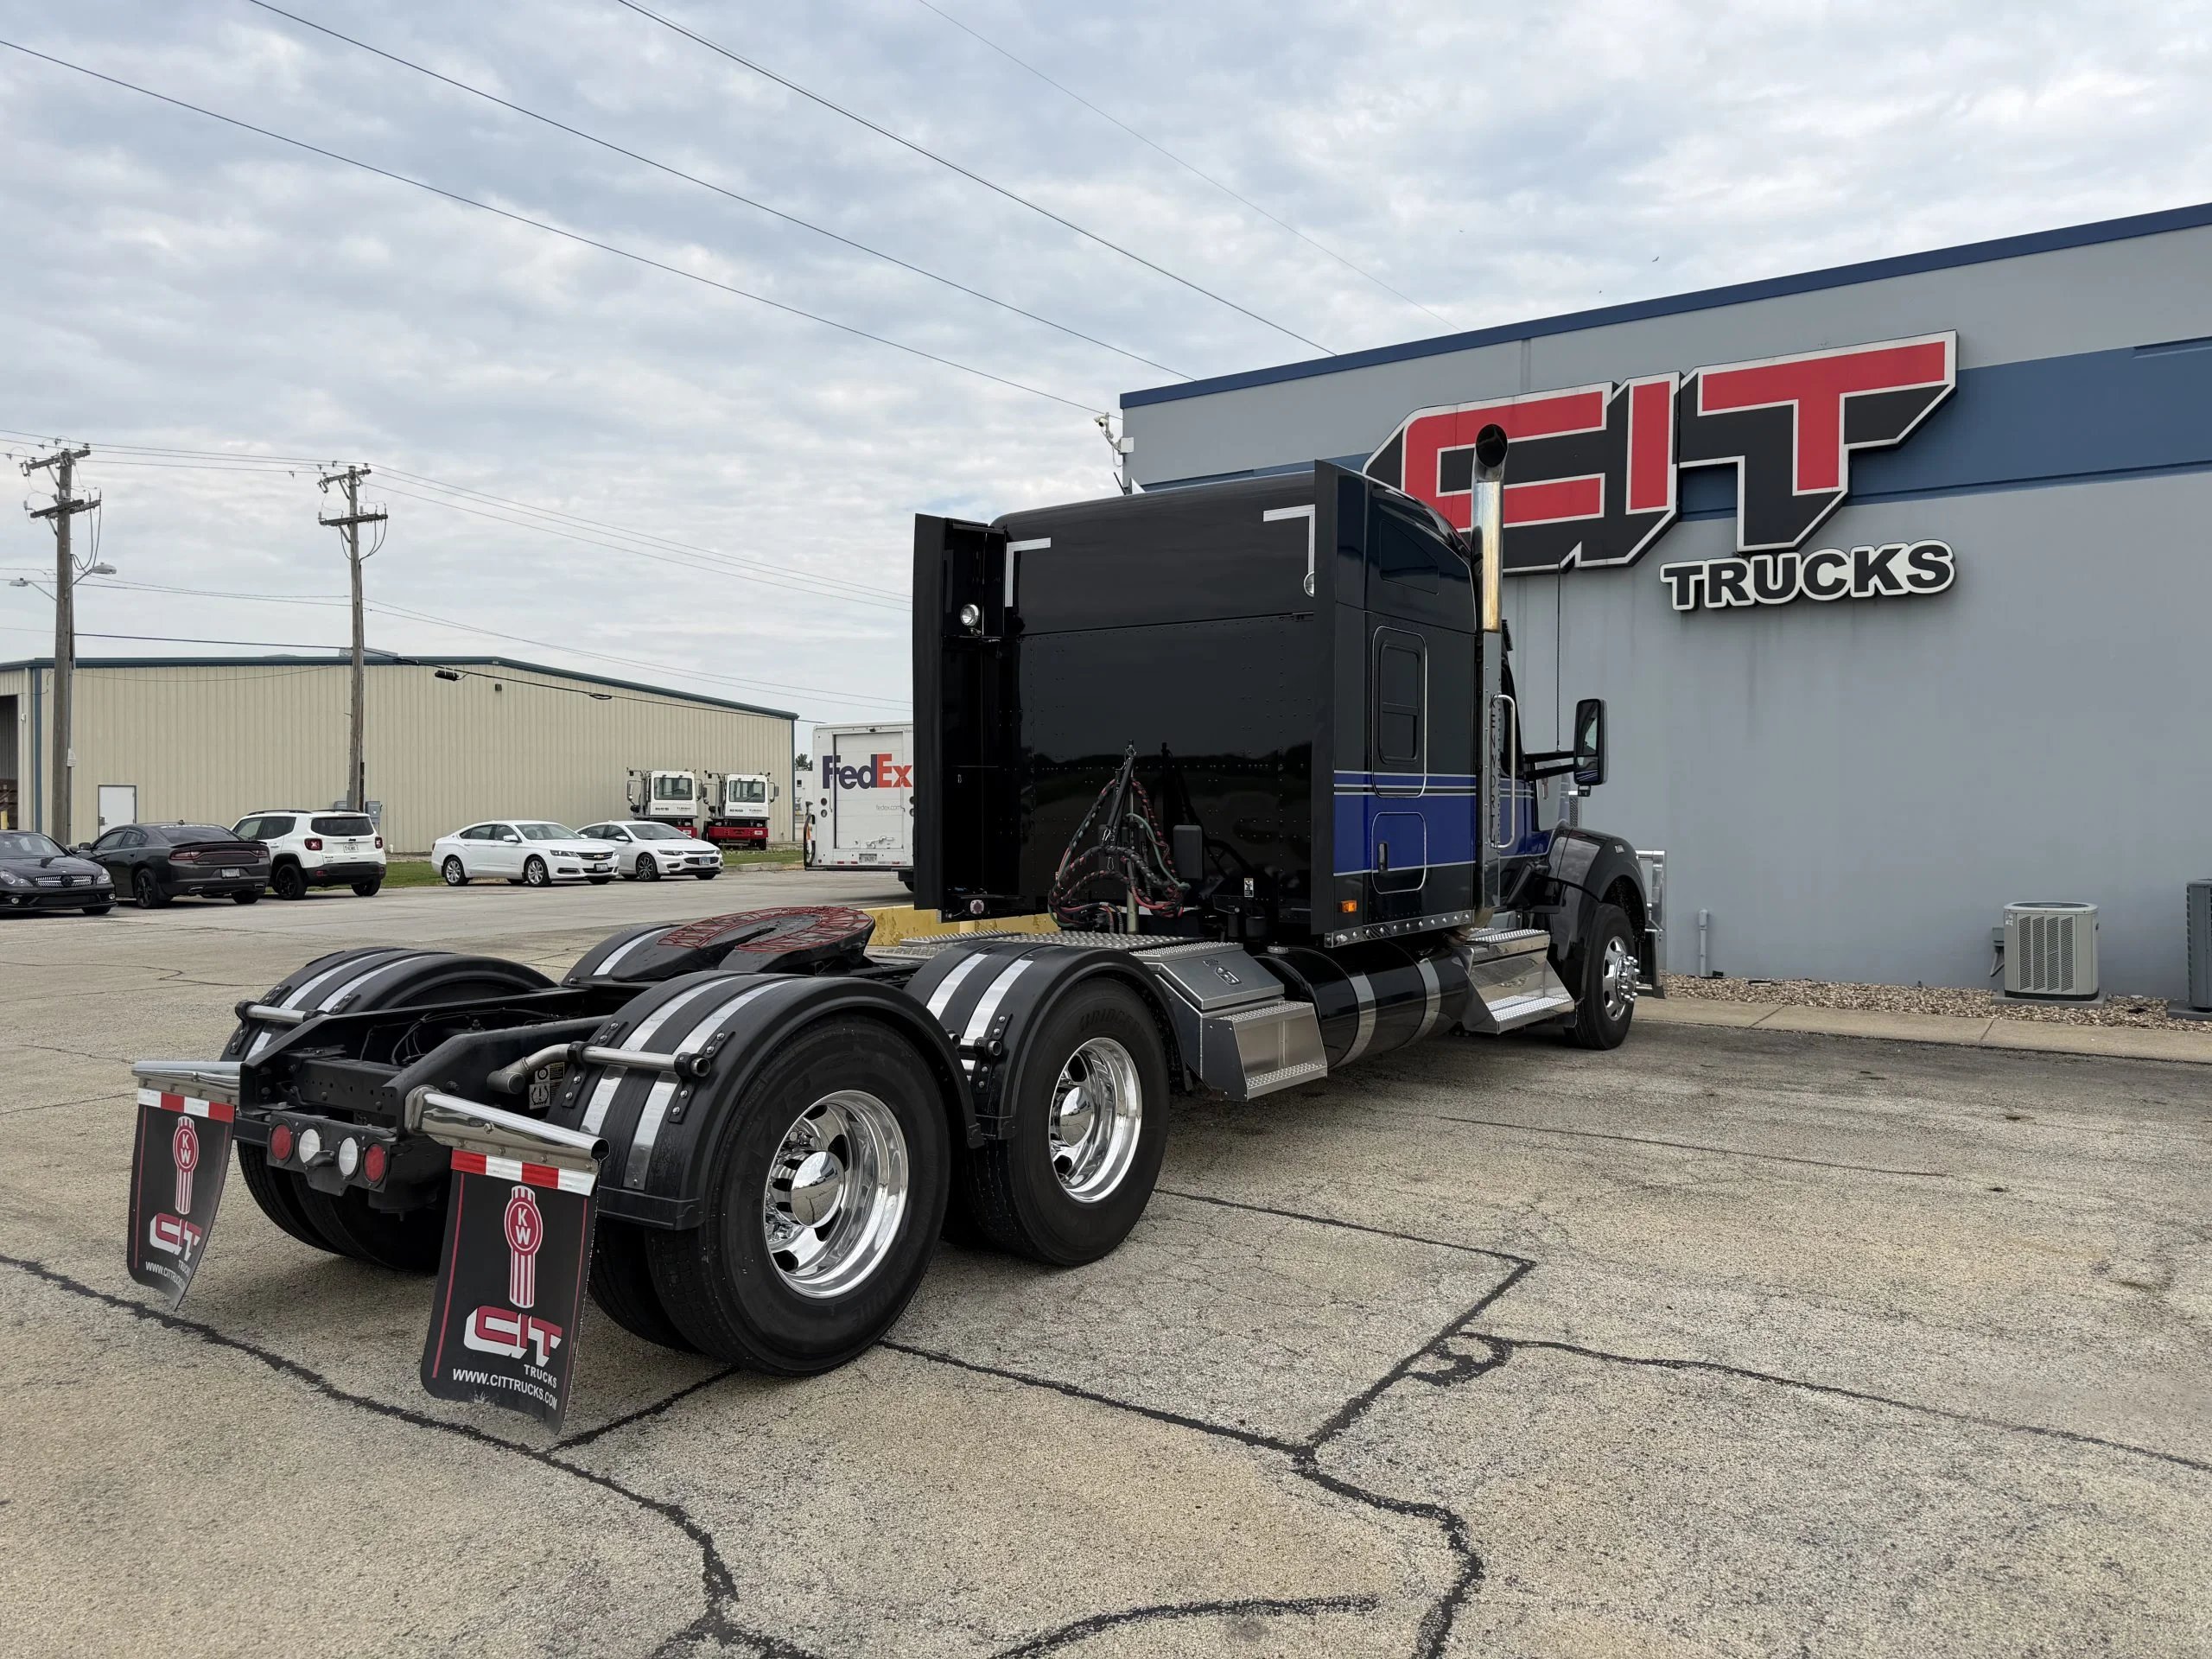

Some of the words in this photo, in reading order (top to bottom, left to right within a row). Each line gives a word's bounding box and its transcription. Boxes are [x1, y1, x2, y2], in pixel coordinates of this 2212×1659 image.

[1367, 330, 1958, 570] CIT
[1662, 541, 1955, 607] TRUCKS
[823, 753, 912, 790] FedEx
[149, 1212, 202, 1262] CIT
[464, 1306, 563, 1367] CIT
[524, 1364, 557, 1389] TRUCKS
